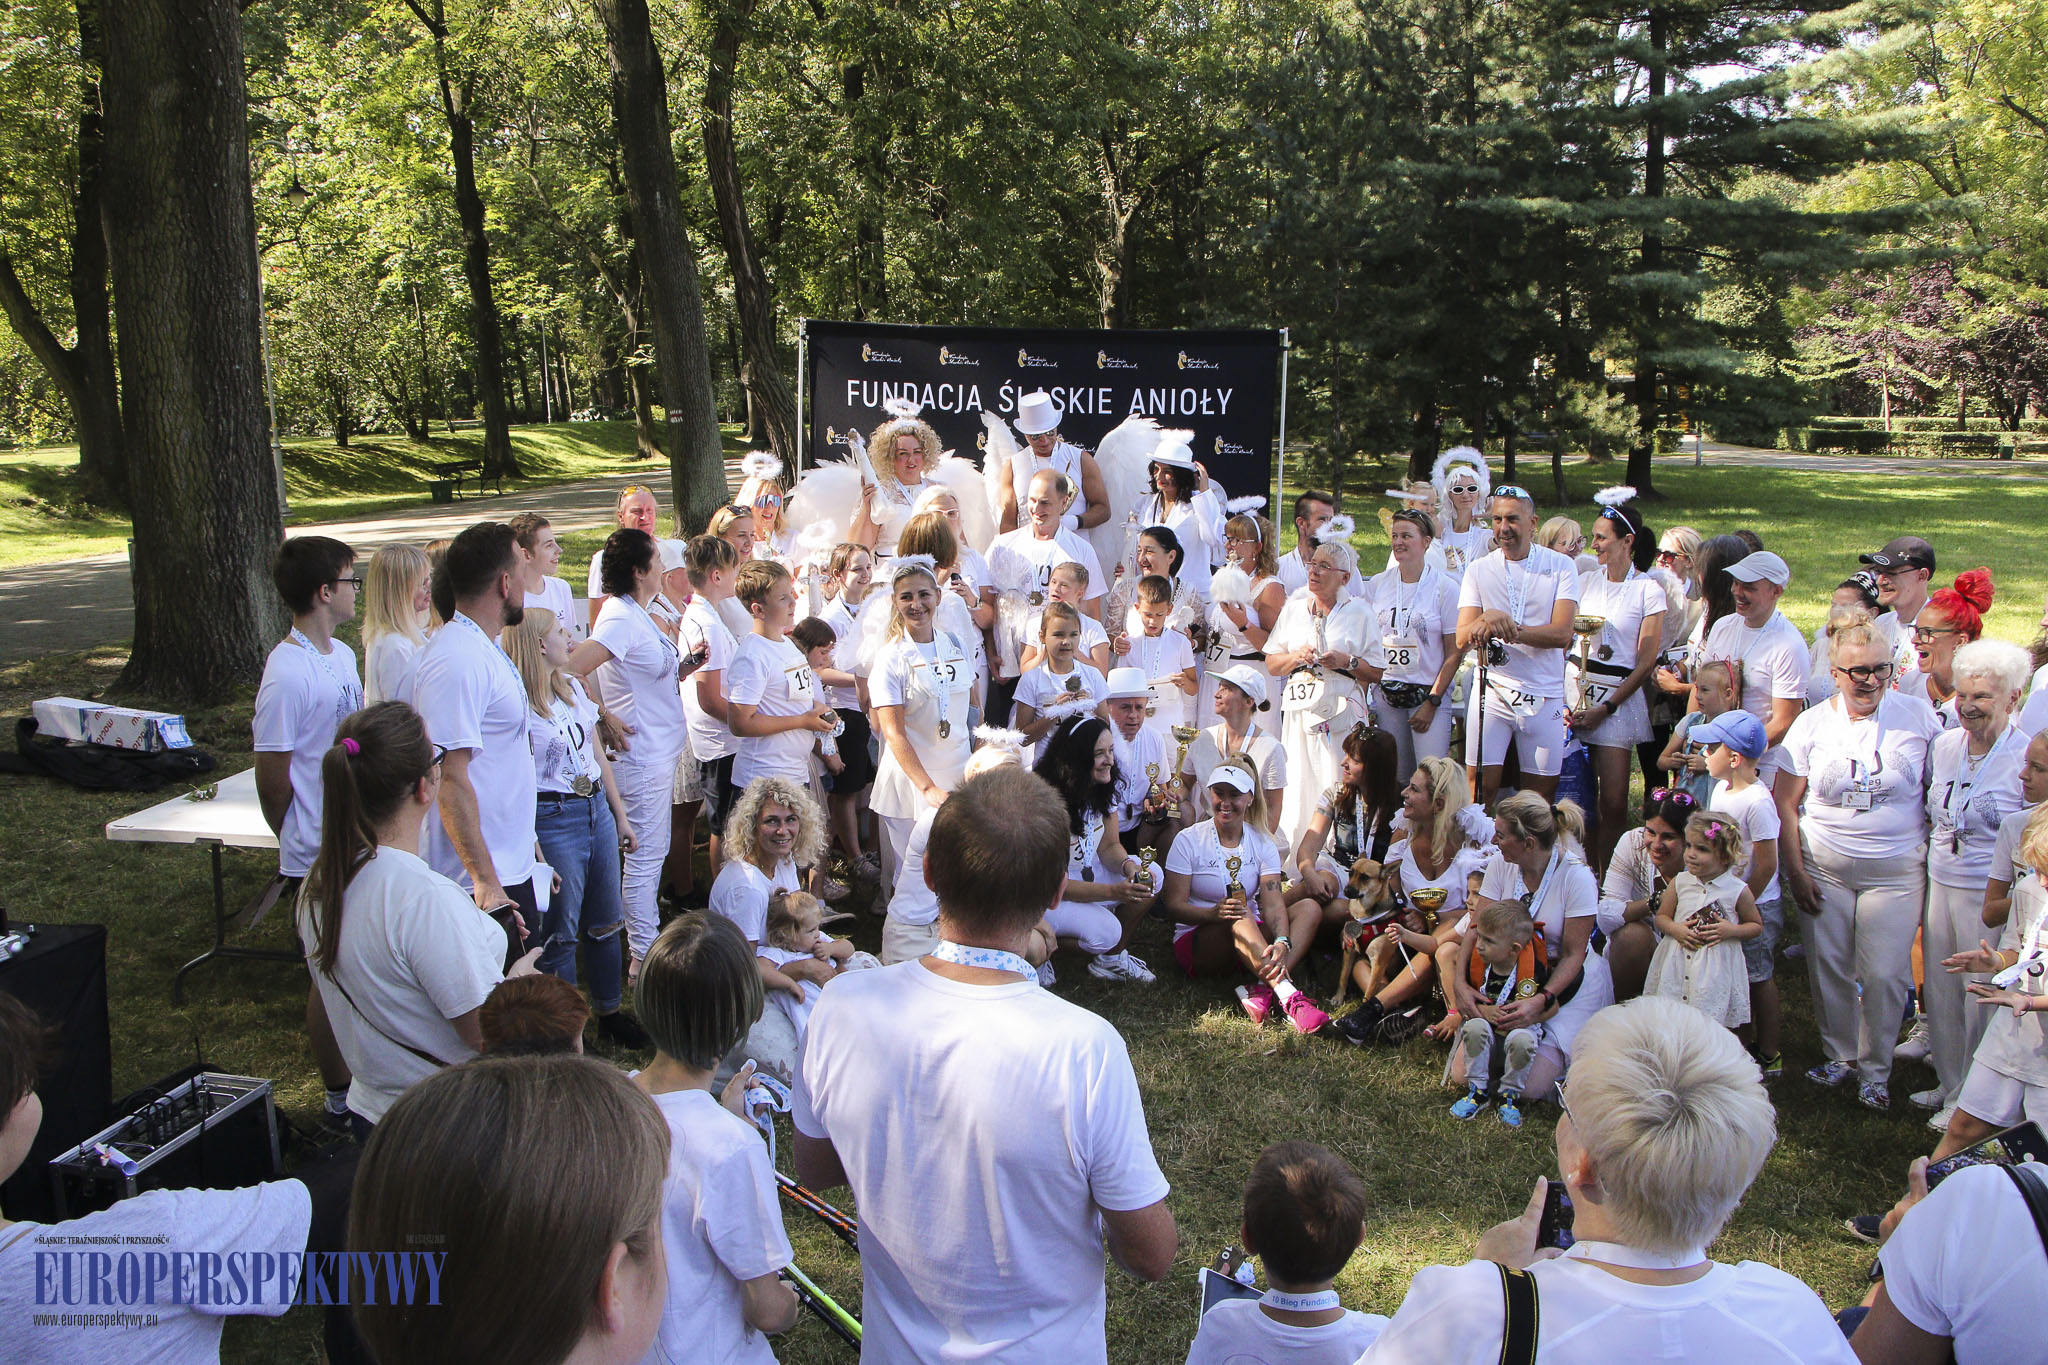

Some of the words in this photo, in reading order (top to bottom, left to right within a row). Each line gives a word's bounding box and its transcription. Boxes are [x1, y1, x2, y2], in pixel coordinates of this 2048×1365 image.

[847, 379, 983, 414] FUNDACJA
[998, 379, 1112, 415] ŚSKIE
[1128, 388, 1233, 416] ANIOŁY
[794, 665, 814, 691] 19
[1288, 683, 1316, 701] 137
[1510, 689, 1536, 707] 24
